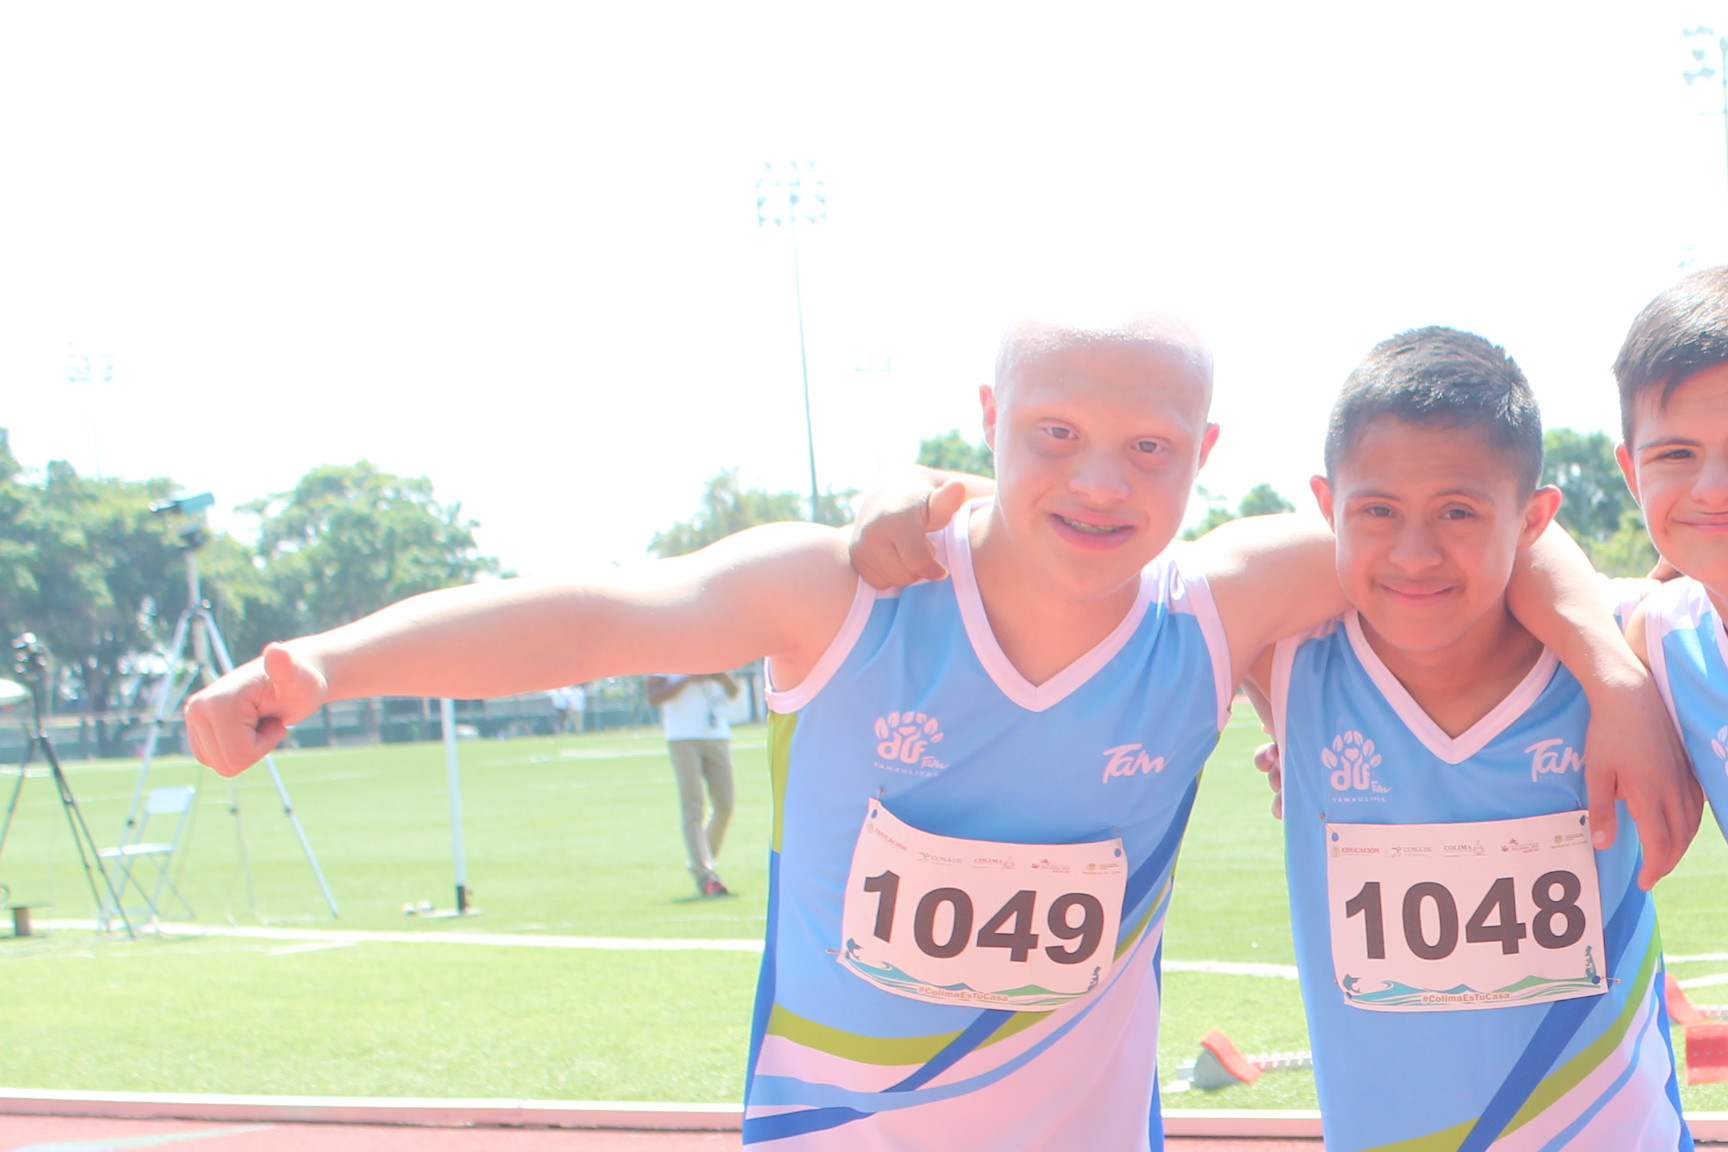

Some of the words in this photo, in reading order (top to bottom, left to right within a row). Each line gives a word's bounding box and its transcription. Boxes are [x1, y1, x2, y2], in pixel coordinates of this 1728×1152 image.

[1102, 743, 1176, 784] Tam
[863, 869, 1104, 964] 1049
[1345, 870, 1586, 960] 1048
[919, 986, 1009, 1002] #ColimaEsTuCasa
[1422, 992, 1511, 1004] #ColimaEsTuCasa
